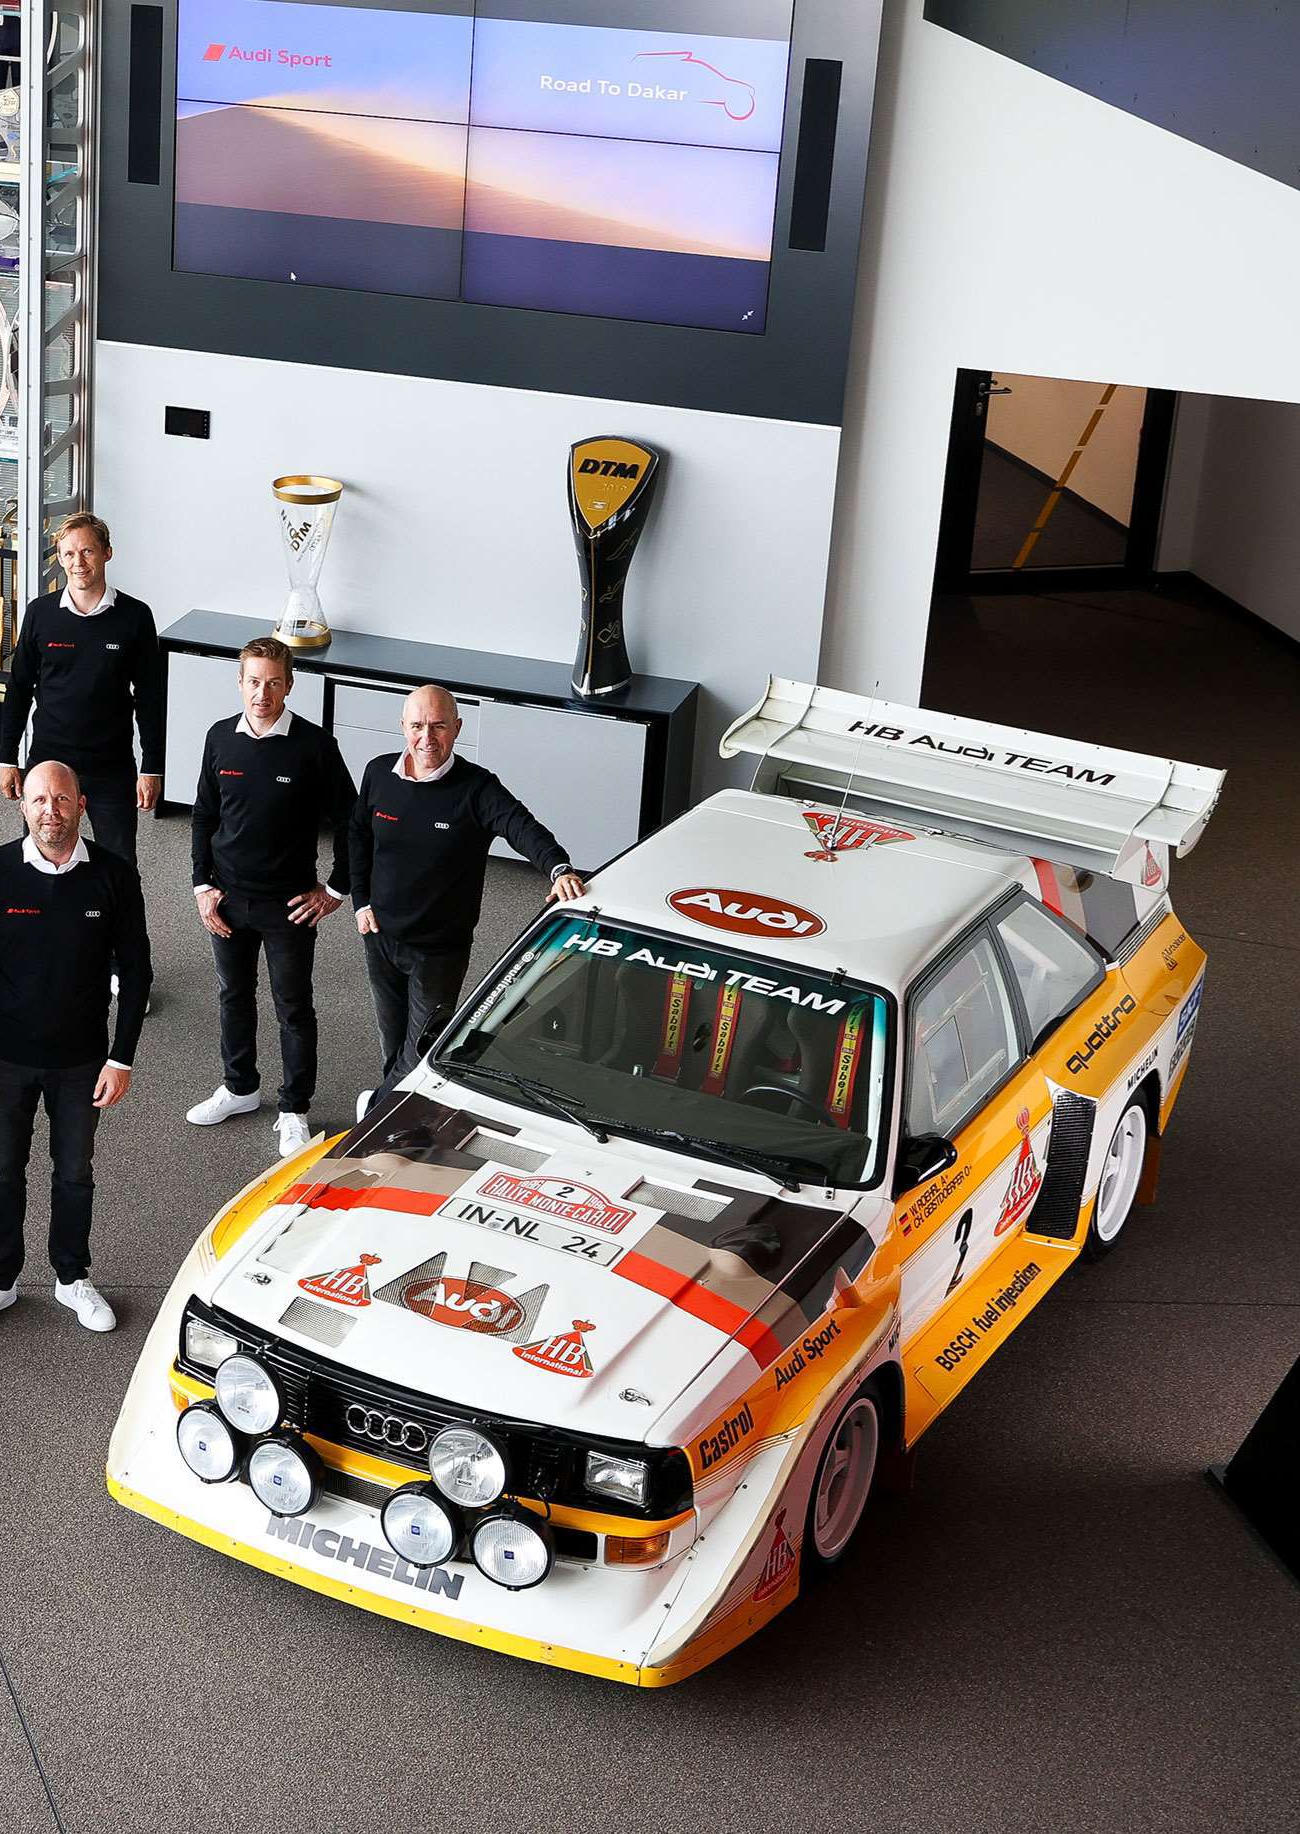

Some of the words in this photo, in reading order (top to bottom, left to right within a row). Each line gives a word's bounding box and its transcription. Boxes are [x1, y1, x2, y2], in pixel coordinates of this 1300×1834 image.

[228, 45, 272, 64] Audi
[277, 48, 333, 69] Sport
[539, 74, 592, 94] Road
[598, 79, 622, 96] To
[627, 80, 689, 102] Dakar
[578, 458, 642, 481] DTM
[847, 719, 905, 742] HB
[908, 734, 997, 762] Audi
[1004, 751, 1117, 787] TEAM
[674, 892, 815, 935] Audi
[561, 934, 625, 957] HB
[624, 947, 718, 981] Audi
[723, 969, 847, 1016] TEAM
[668, 998, 682, 1048] Sabelt
[714, 1021, 730, 1072] Sabelt
[1065, 993, 1137, 1075] quattro
[836, 1054, 852, 1106] Sabelt
[1127, 1045, 1159, 1091] MICHELIN
[487, 1176, 533, 1203] RALLYE
[527, 1194, 625, 1231] MONTE-CARLO
[556, 1186, 576, 1198] 2
[458, 1204, 540, 1241] IN-NL
[561, 1236, 602, 1259] 24
[943, 1208, 973, 1299] 2
[303, 1281, 362, 1305] International
[319, 1269, 368, 1295] HB
[415, 1283, 521, 1328] Audi
[935, 1327, 980, 1372] BOSCH
[974, 1291, 1002, 1338] fuel
[997, 1261, 1042, 1313] injection
[520, 1350, 584, 1377] International
[535, 1336, 587, 1366] HB
[773, 1355, 806, 1391] Audi
[803, 1318, 842, 1362] Sport
[699, 1402, 755, 1470] Castrol
[266, 1514, 465, 1600] MICHELIN
